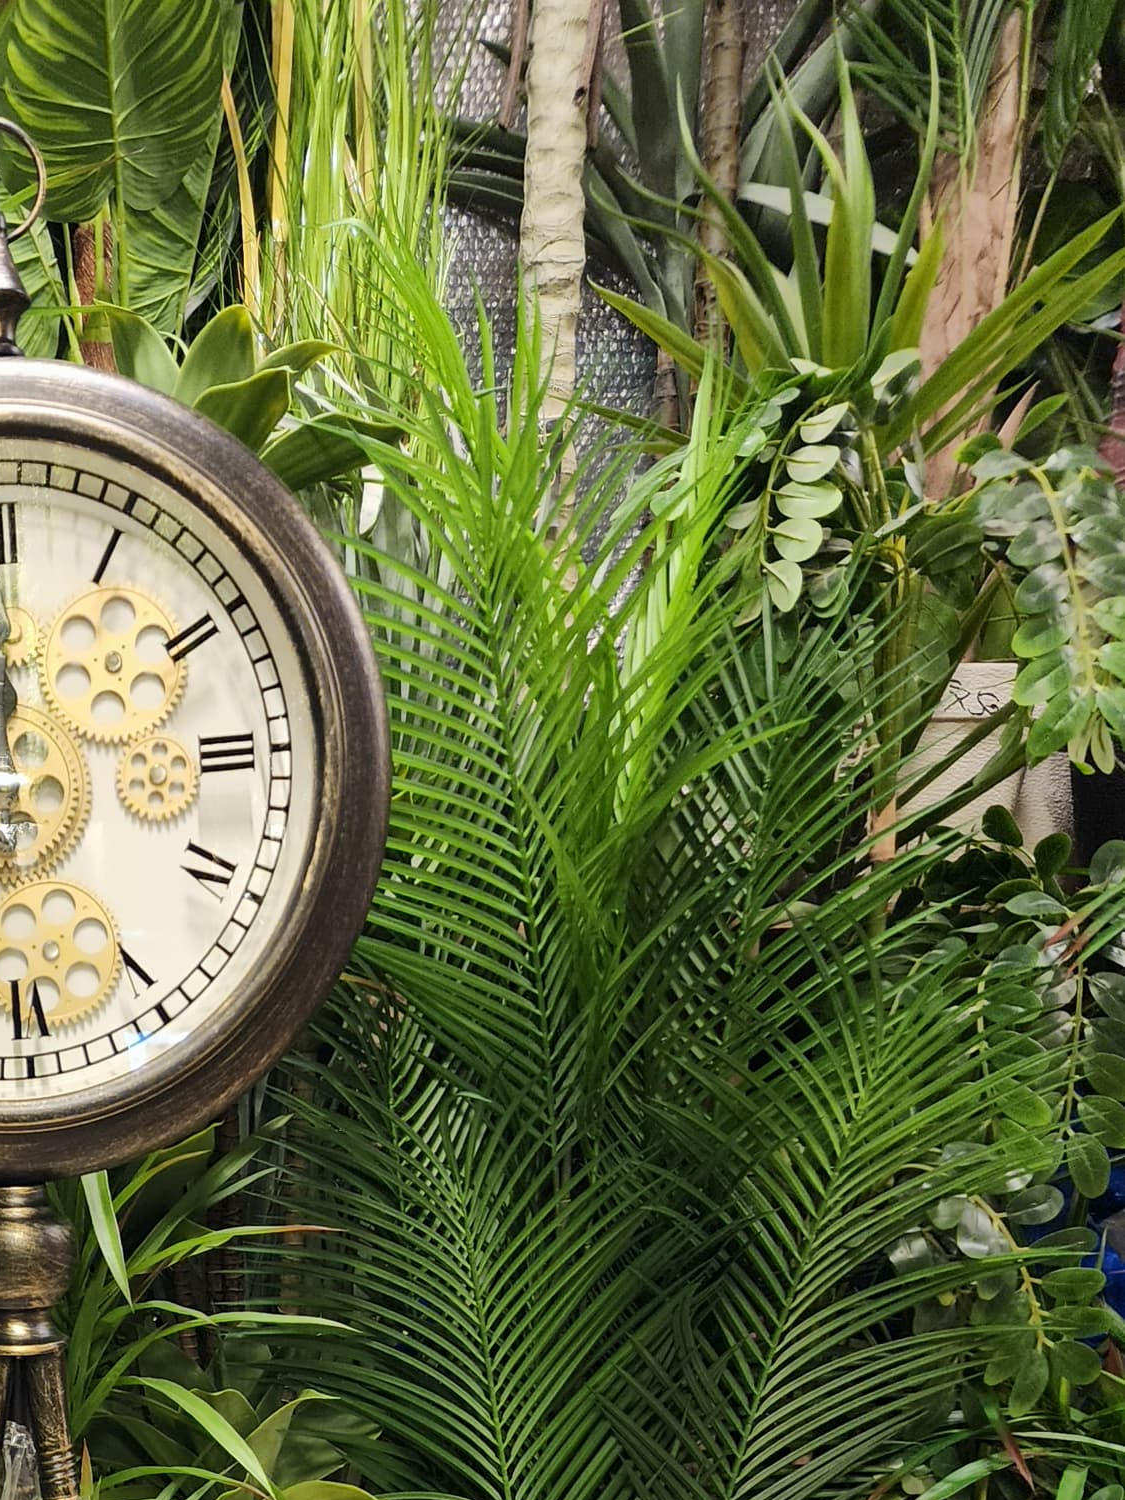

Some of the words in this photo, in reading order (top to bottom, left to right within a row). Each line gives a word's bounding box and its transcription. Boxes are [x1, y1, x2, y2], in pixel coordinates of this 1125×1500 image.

[92, 527, 125, 583] I
[164, 613, 219, 663] II
[199, 732, 253, 776] III
[179, 842, 237, 901] IV
[118, 943, 159, 999] V
[10, 979, 52, 1041] VI
